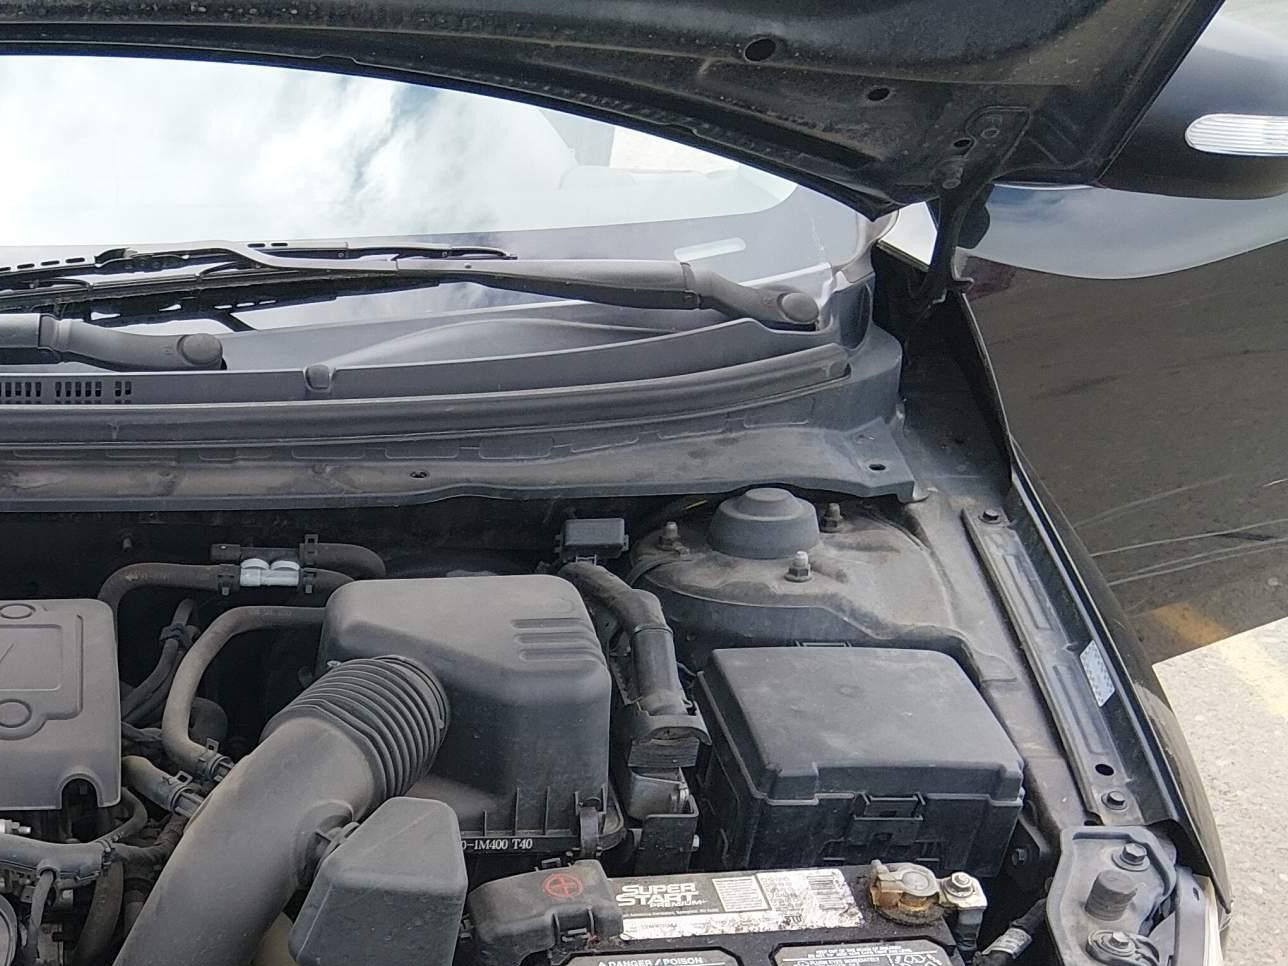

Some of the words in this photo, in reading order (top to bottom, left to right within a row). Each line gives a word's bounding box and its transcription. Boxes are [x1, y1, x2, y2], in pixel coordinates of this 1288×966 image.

[512, 838, 533, 850] T40
[621, 882, 697, 896] SUPER
[615, 892, 699, 907] START
[650, 900, 702, 908] PREMIUM
[663, 957, 703, 965] POISON
